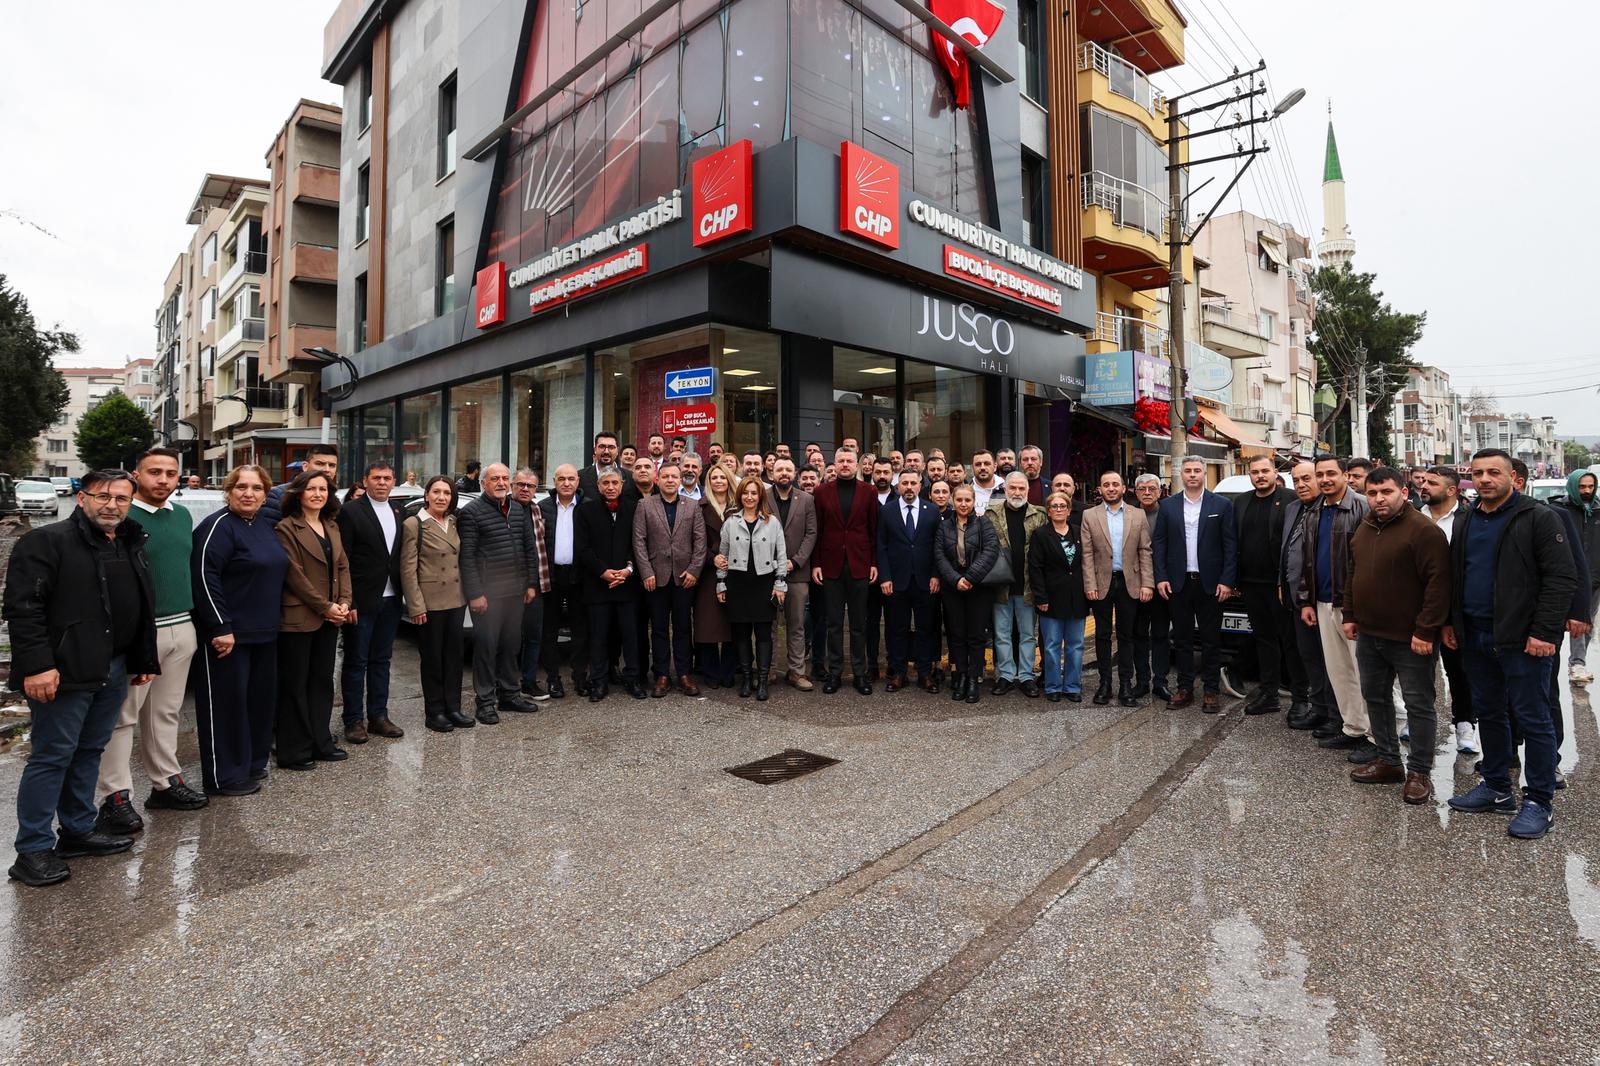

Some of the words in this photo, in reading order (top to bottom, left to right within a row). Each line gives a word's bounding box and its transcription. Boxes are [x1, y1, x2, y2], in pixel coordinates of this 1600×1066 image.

[619, 189, 682, 242] PARTİSİ
[699, 203, 739, 237] CHP
[854, 205, 892, 238] CHP
[907, 199, 1010, 260] CUMHURİYET
[1008, 243, 1043, 274] HALK
[1041, 258, 1083, 291] PARTİSİ
[948, 250, 983, 279] BUCA
[982, 259, 1009, 288] İLÇE
[1007, 273, 1062, 308] BAŞKANLIĞI
[479, 302, 497, 323] CHP
[917, 296, 1015, 356] JUSCO
[981, 358, 1009, 374] HALI
[677, 380, 692, 388] TEK
[676, 419, 686, 427] İLÇE
[686, 417, 714, 426] BAŞKANLIĞI
[1224, 618, 1242, 629] CJF
